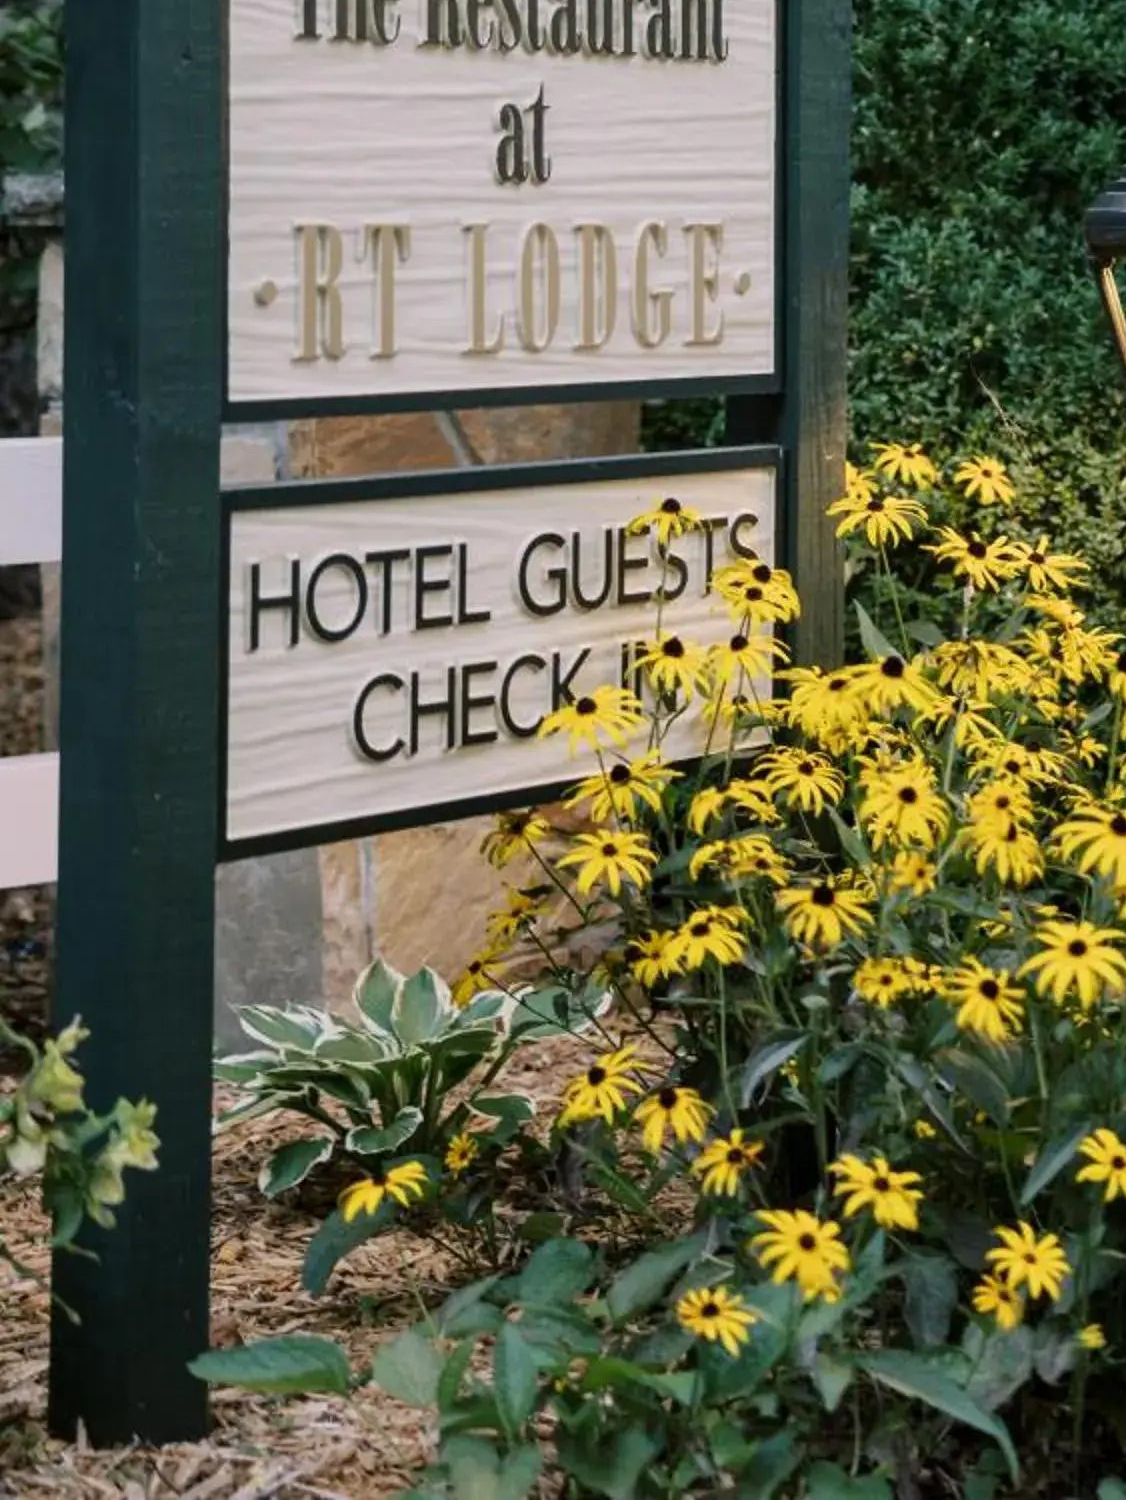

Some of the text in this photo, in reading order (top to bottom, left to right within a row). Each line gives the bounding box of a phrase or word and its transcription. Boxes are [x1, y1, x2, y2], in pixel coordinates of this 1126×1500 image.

[494, 80, 552, 187] at
[290, 220, 726, 365] RT LODGE
[249, 542, 491, 652] HOTEL
[353, 646, 592, 762] CHECK
